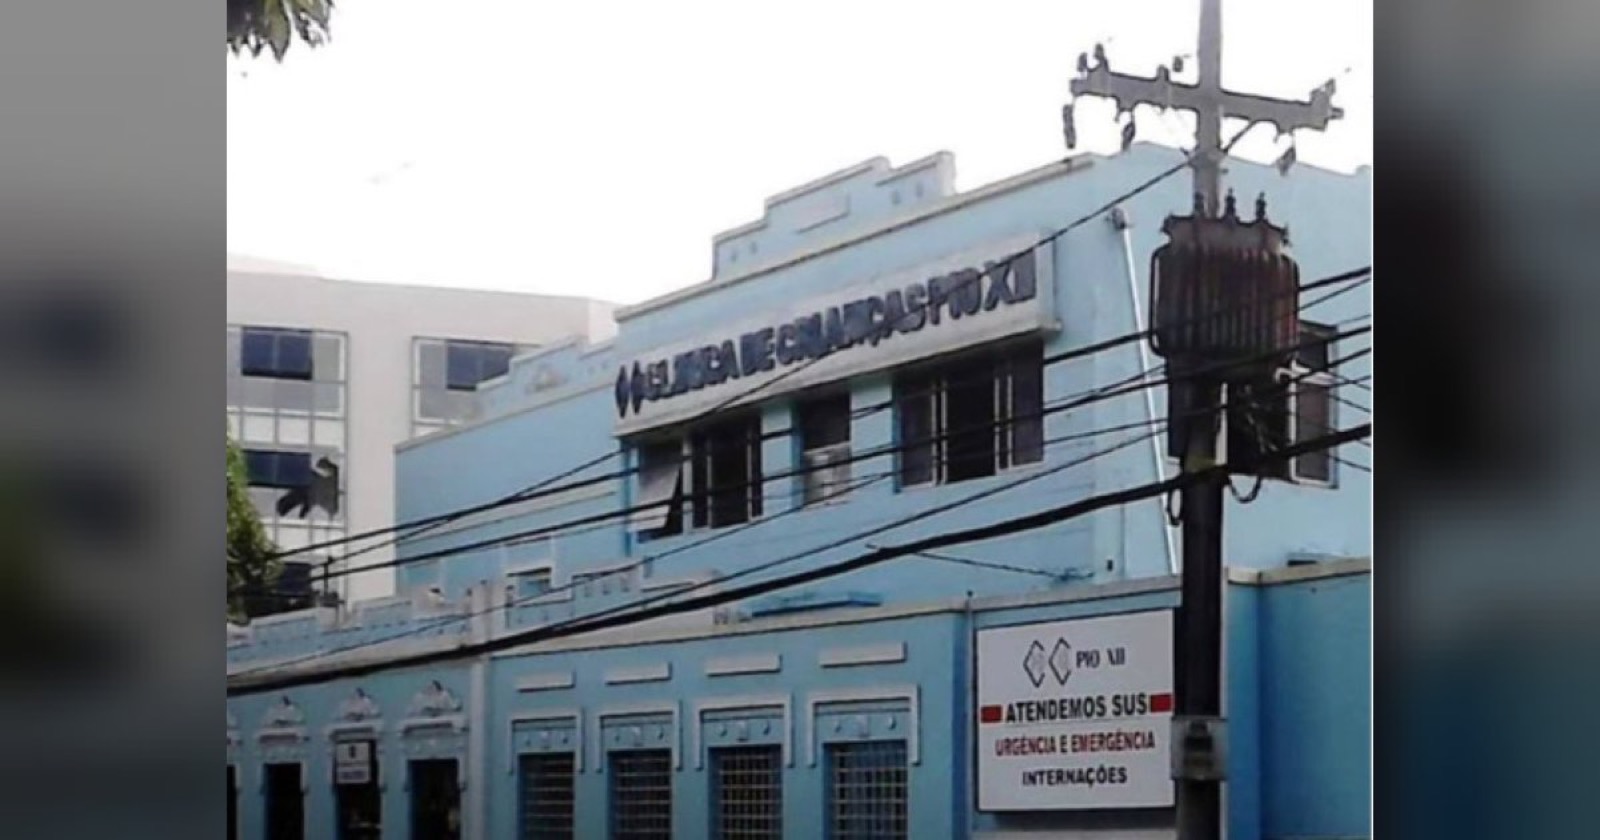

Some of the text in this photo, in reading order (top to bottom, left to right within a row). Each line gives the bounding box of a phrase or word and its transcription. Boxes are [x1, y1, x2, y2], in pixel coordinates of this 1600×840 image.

[740, 327, 776, 376] DE
[927, 267, 981, 325] PIO
[982, 248, 1036, 311] XII
[1076, 649, 1101, 669] PIO
[1006, 693, 1147, 723] ATENDEMOS SUS
[995, 728, 1156, 757] URGÊNCIA E EMERGÊNCIA
[1022, 764, 1128, 788] INTERNAÇÕES
